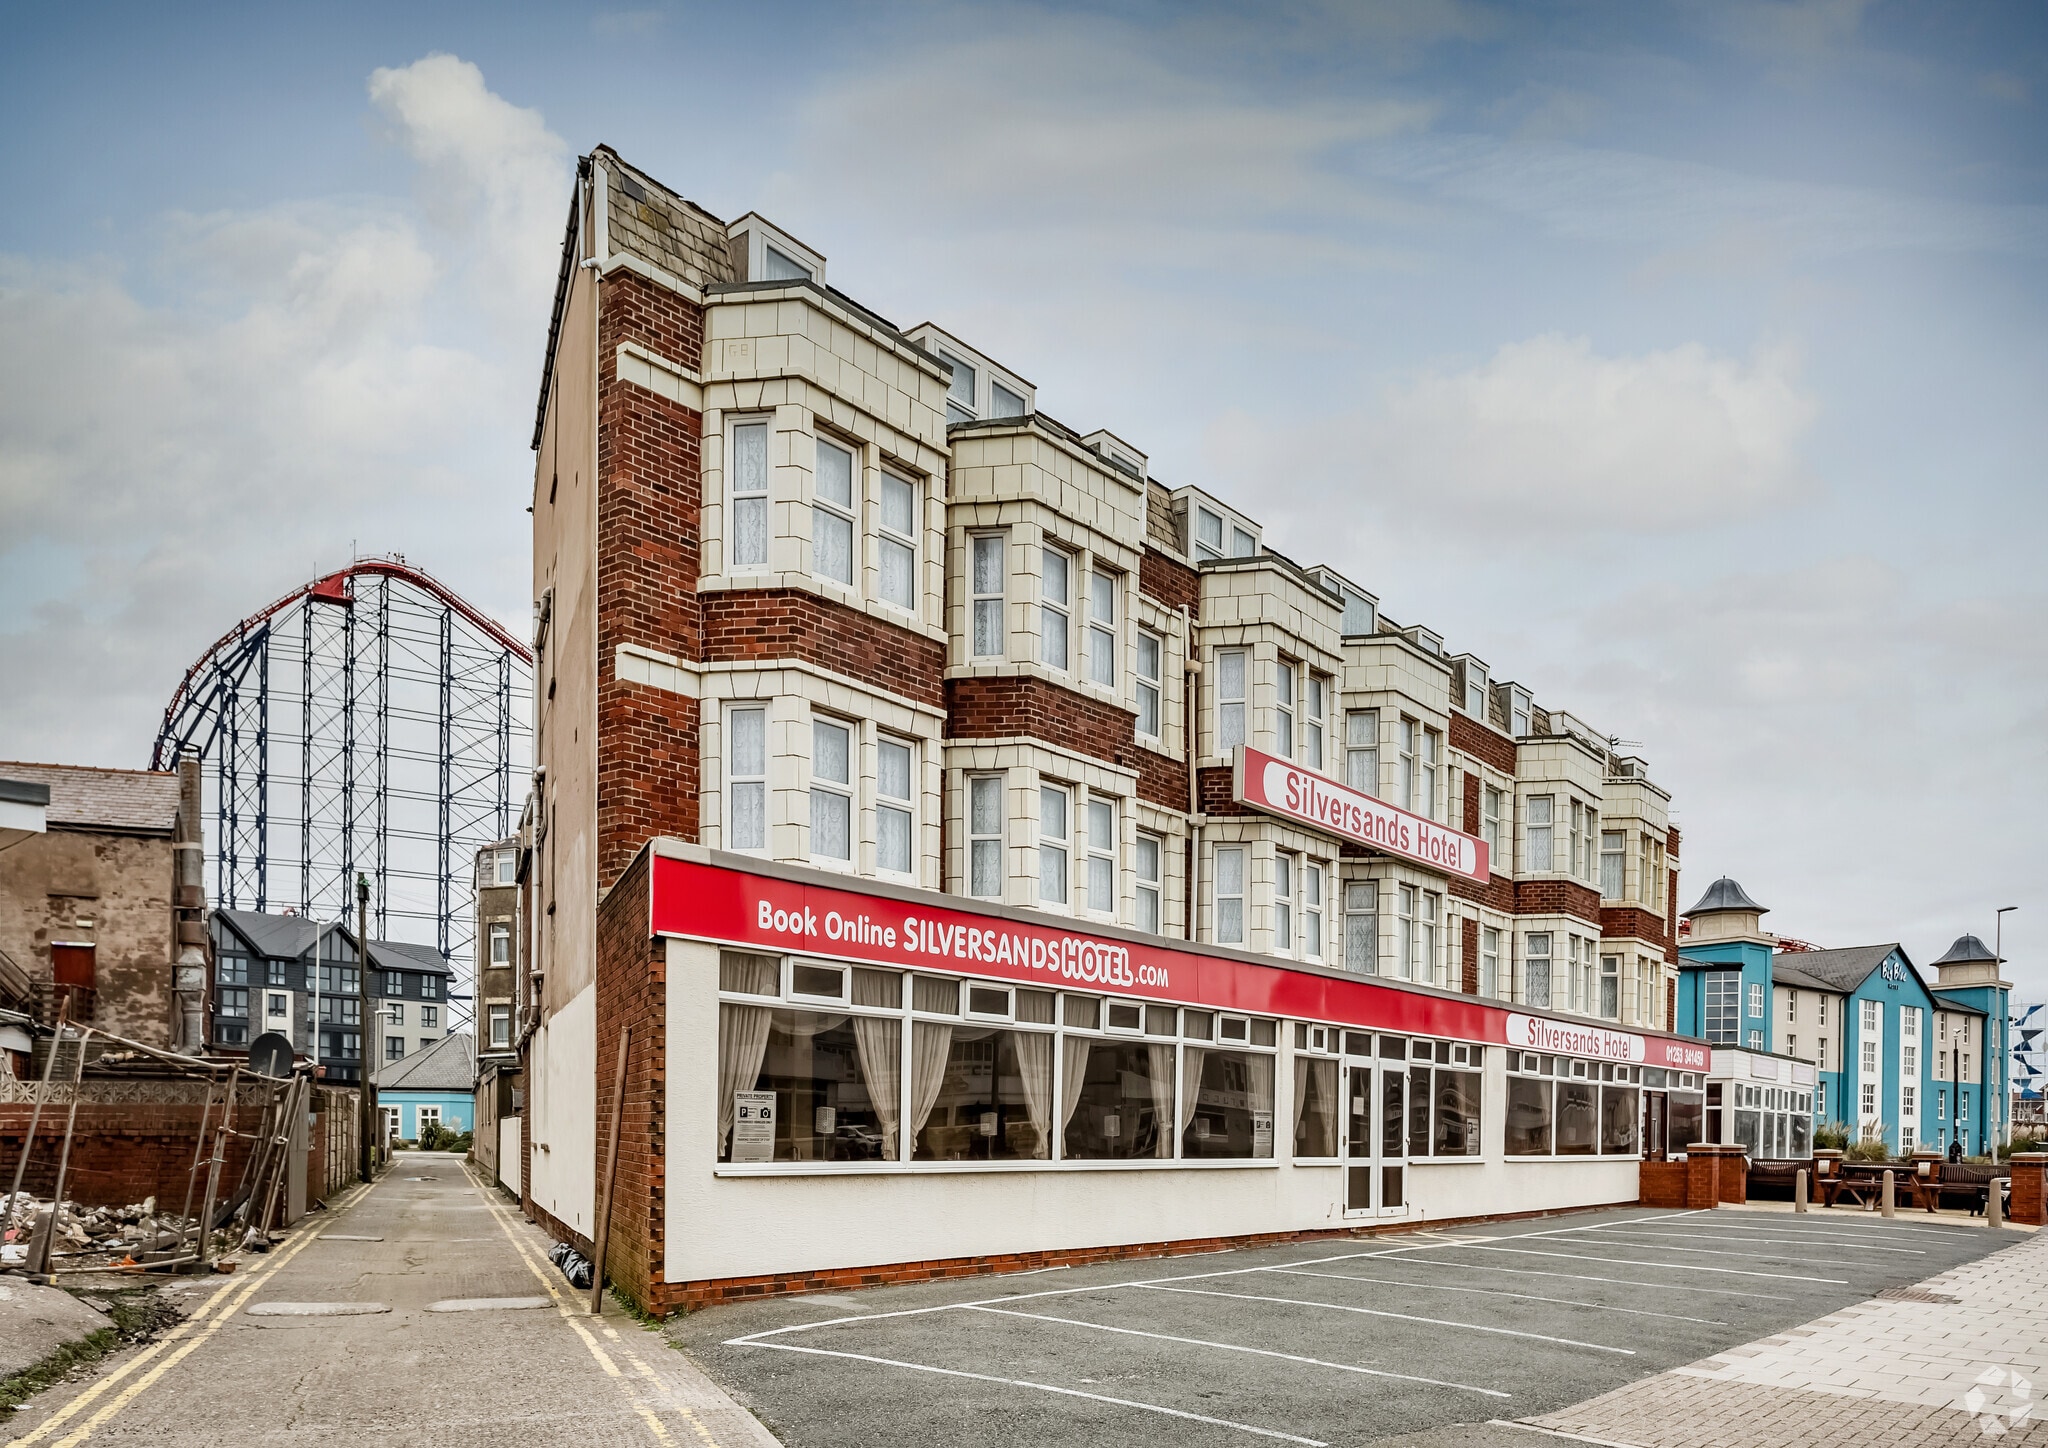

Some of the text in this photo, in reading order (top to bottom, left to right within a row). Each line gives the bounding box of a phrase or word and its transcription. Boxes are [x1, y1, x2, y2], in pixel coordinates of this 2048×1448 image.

[1285, 771, 1462, 869] Silversands Hotel
[757, 899, 818, 936] Book
[824, 911, 897, 949] Online
[1527, 1017, 1631, 1060] Silversands Hotel
